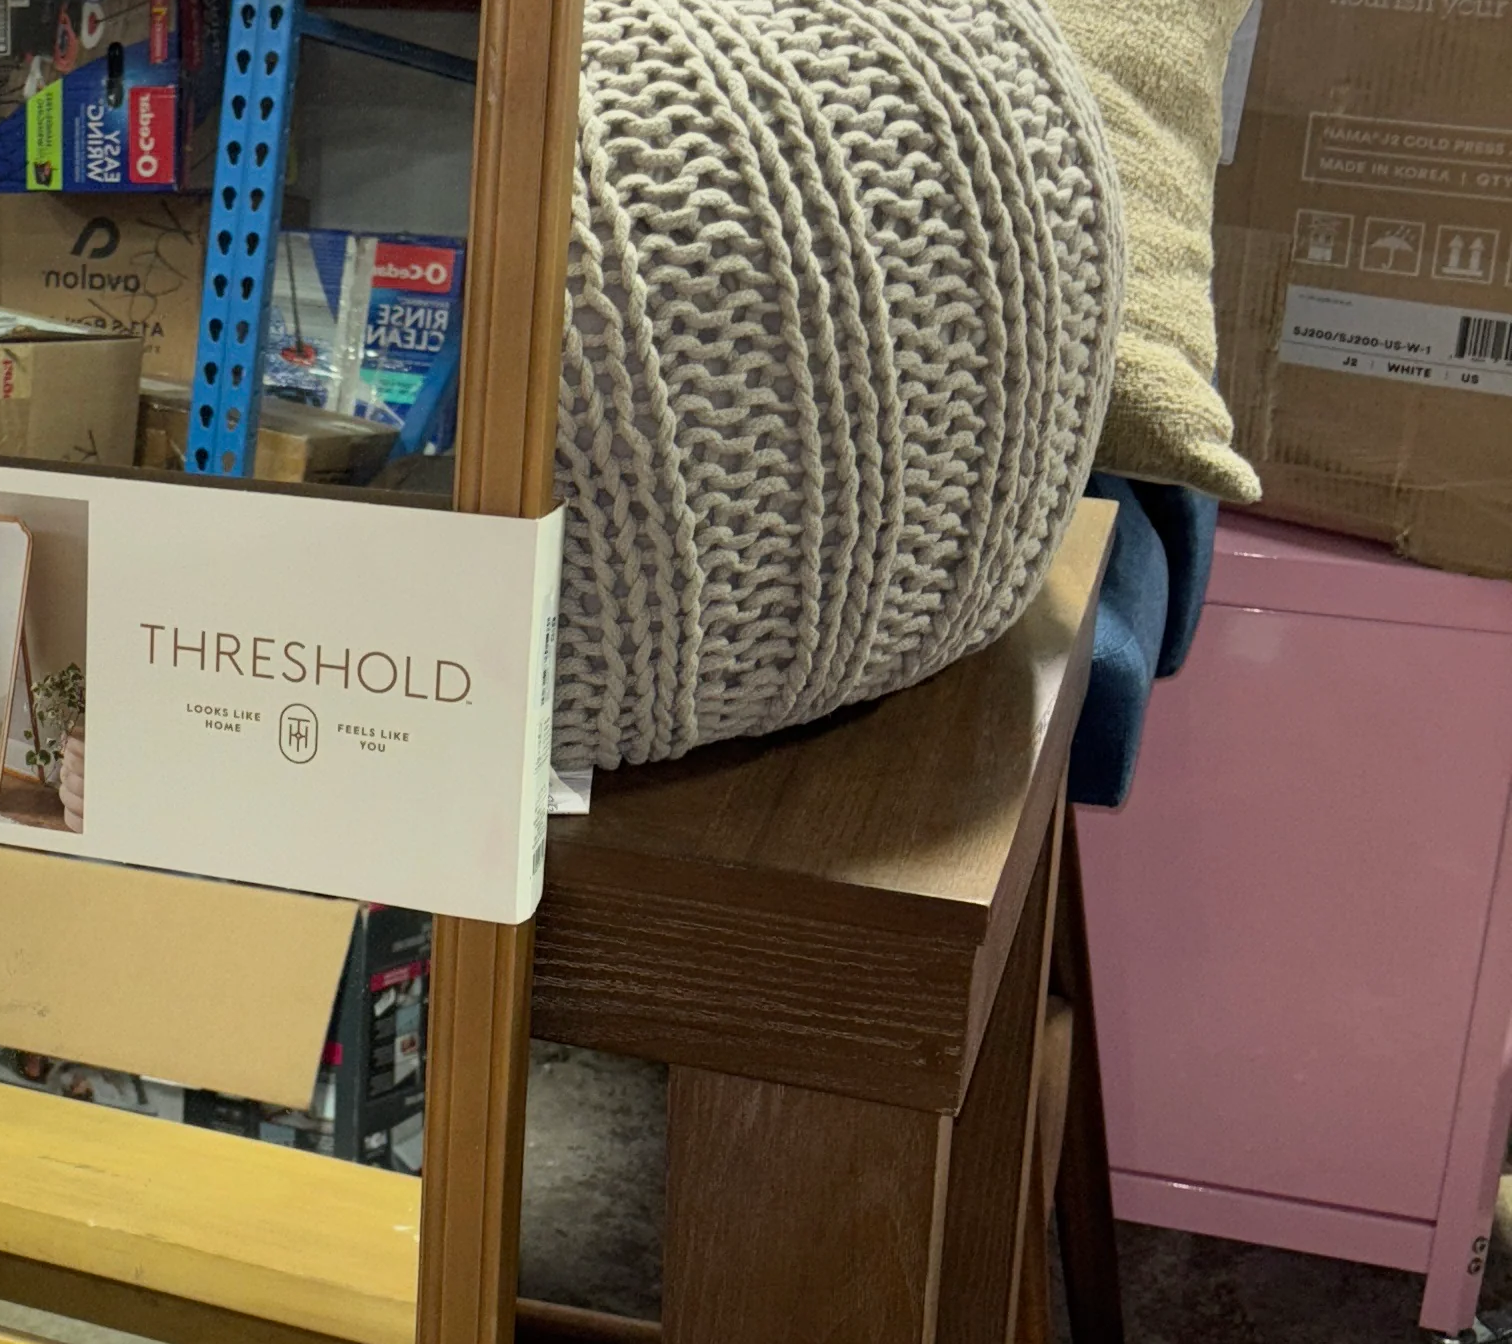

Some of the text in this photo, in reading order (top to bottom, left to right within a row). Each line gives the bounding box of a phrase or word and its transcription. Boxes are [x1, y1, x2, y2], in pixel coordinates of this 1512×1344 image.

[1403, 135, 1450, 151] COLD
[1453, 140, 1506, 156] PRESS
[1319, 157, 1367, 174] MADE
[1371, 163, 1388, 176] IN
[1394, 165, 1451, 183] KOREA
[1342, 355, 1480, 385] J2 WHITE US
[140, 622, 472, 704] THRESHOLD
[186, 703, 262, 723] LOOKS LIKE
[204, 719, 242, 734] HOME
[337, 723, 410, 743] FEELS LIKE
[359, 739, 387, 754] YOU
